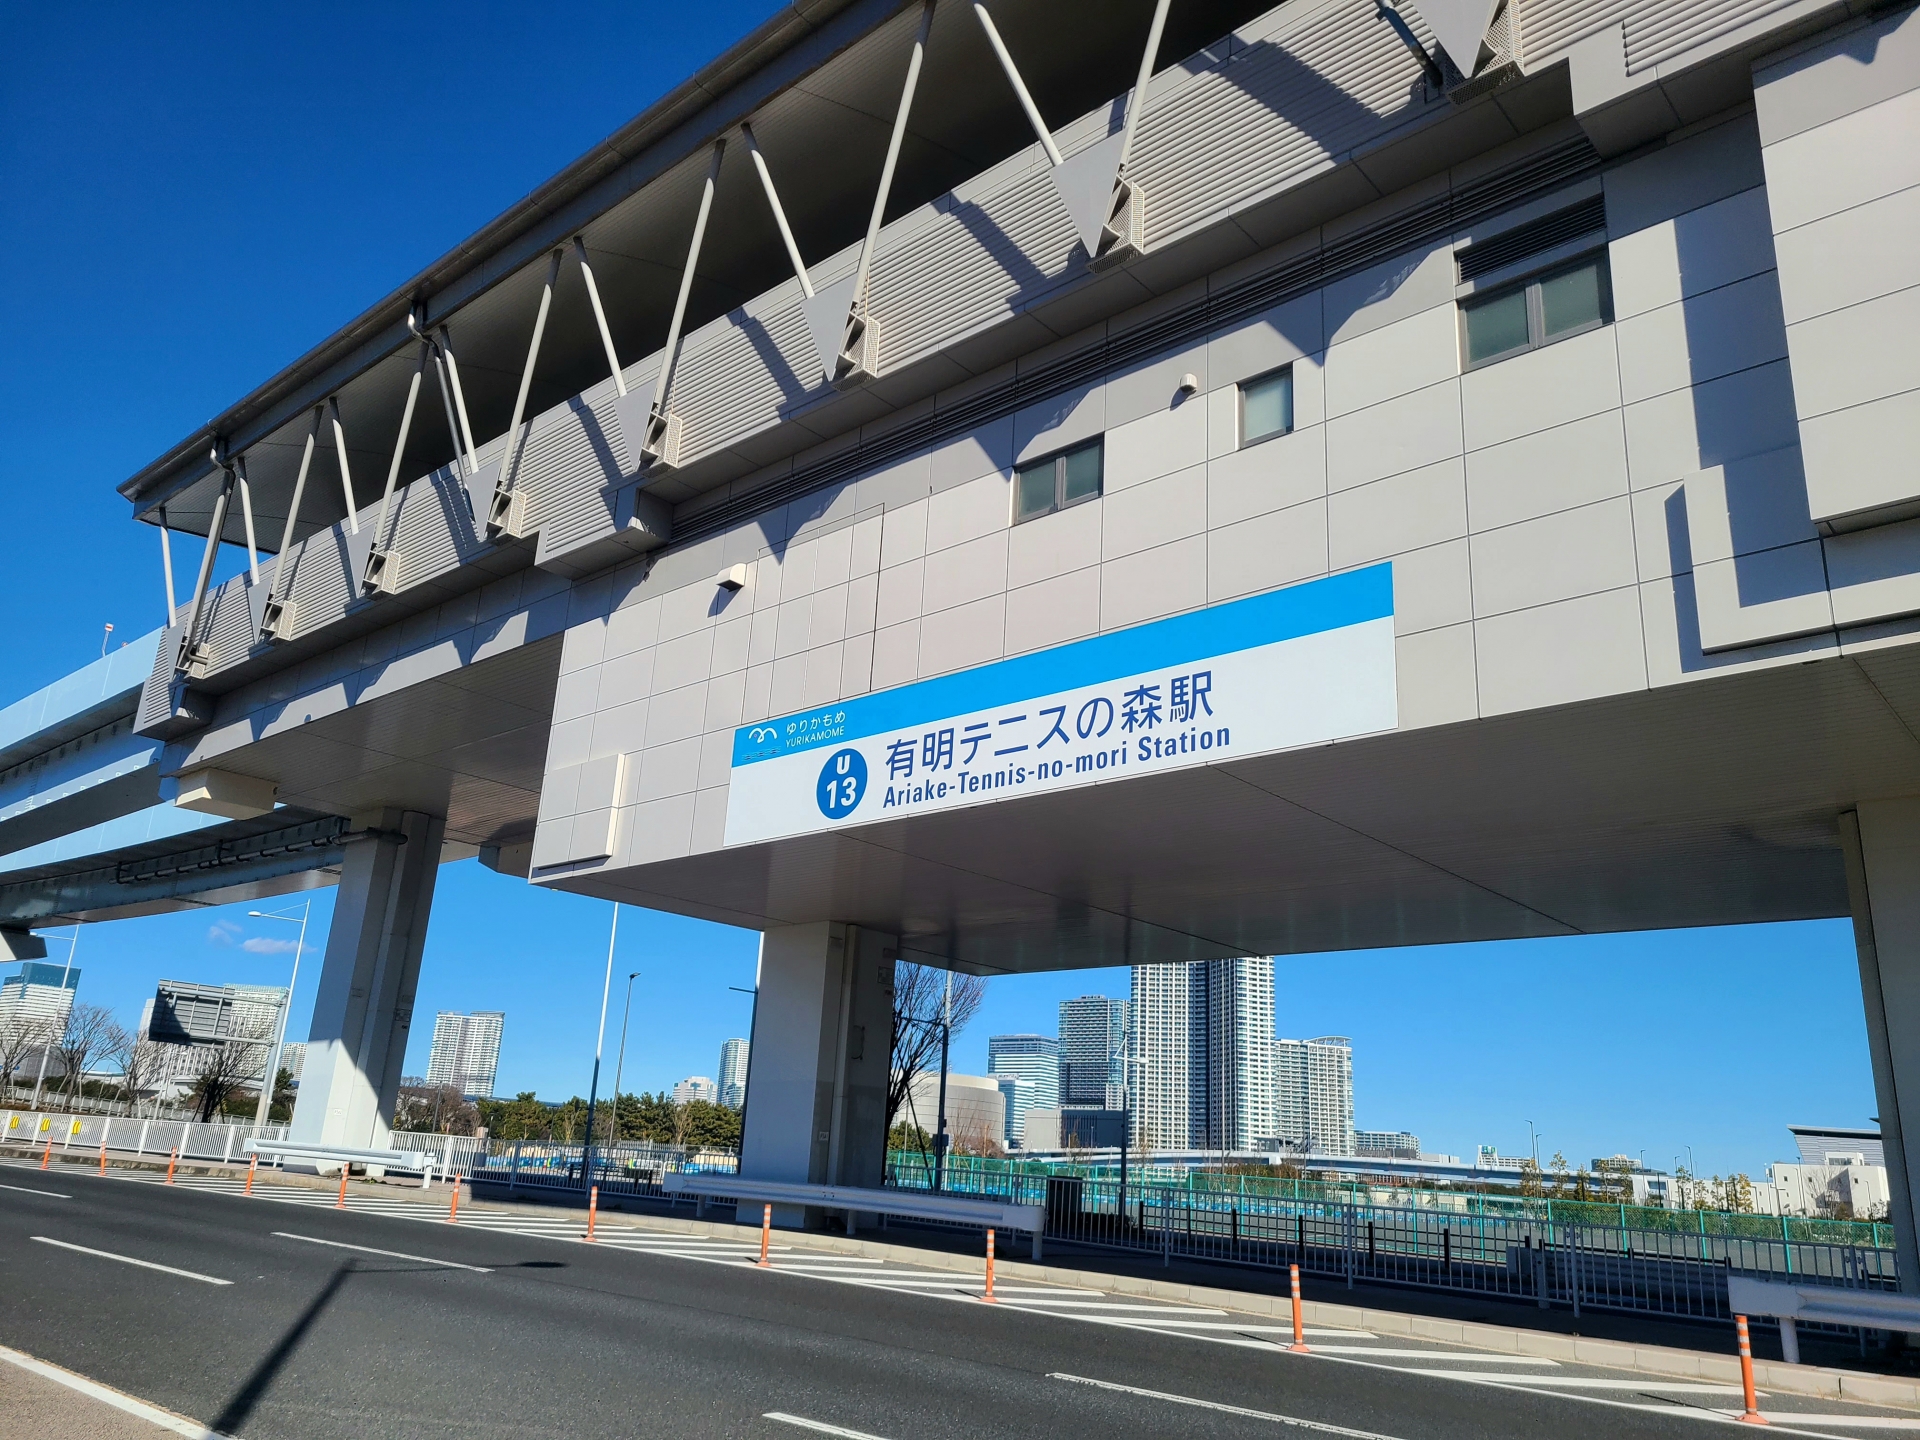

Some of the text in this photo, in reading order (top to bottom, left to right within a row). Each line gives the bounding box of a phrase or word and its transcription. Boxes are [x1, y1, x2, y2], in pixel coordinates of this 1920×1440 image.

[785, 725, 845, 748] YURIKAMOME
[786, 710, 846, 736] ゆりかもめ
[885, 670, 1214, 781] 有明テニスの森駅
[836, 754, 851, 775] U
[882, 726, 1230, 809] Ariake-Tennis-no-mori Station
[826, 776, 857, 809] 13
